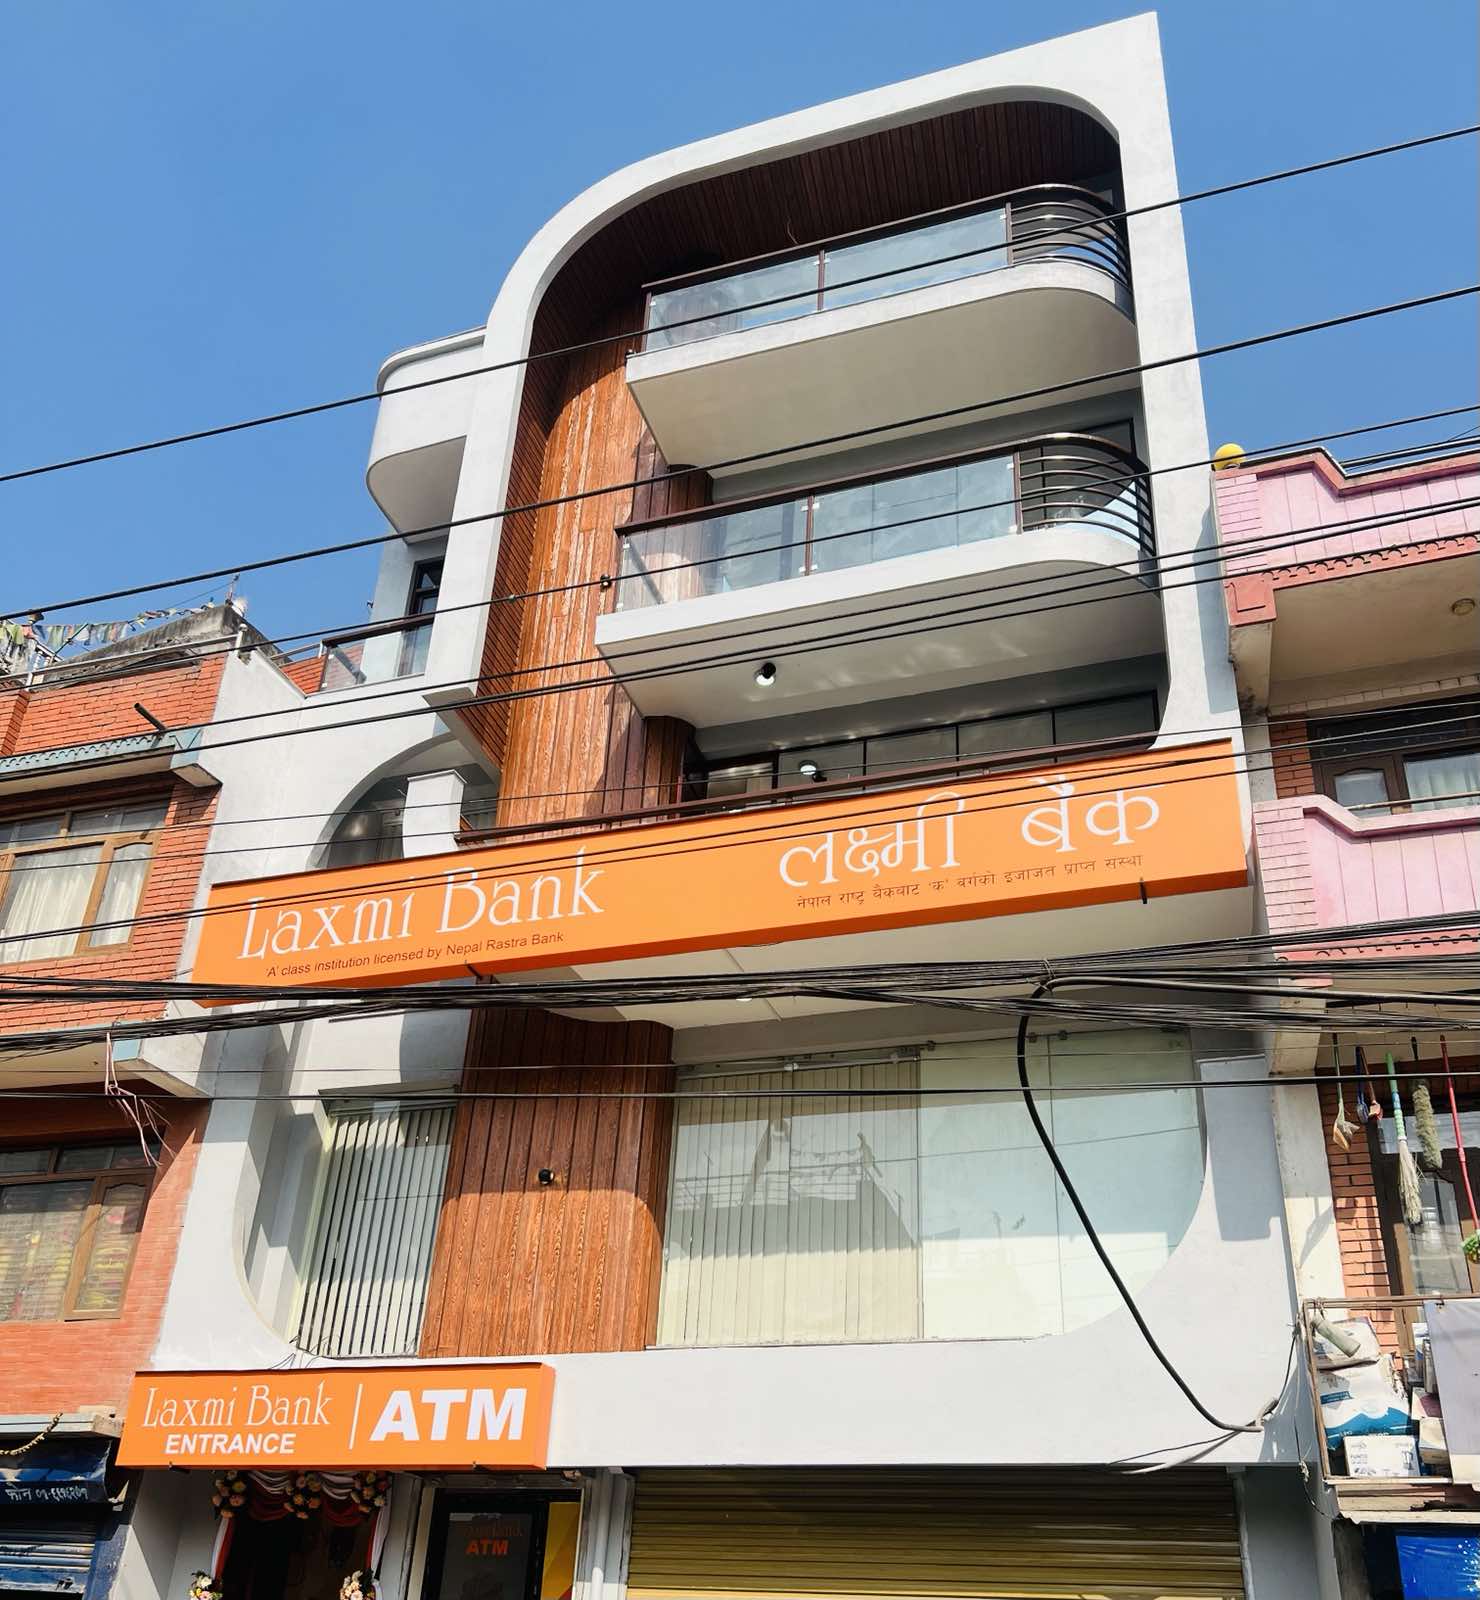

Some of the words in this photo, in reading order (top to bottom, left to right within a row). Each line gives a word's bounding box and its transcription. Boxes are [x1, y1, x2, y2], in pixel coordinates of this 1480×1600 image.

[780, 791, 966, 887] लक्ष्मी
[1021, 774, 1163, 853] बैंक
[236, 877, 415, 960] Laxmi
[436, 846, 606, 934] Bank
[796, 895, 832, 909] नेपाल
[957, 870, 996, 888] वर्गको
[1004, 865, 1057, 884] इजाजत
[1064, 860, 1097, 875] प्राप्त
[280, 962, 311, 975] class
[315, 956, 370, 972] institution
[374, 946, 424, 963] licensed
[427, 947, 442, 960] by
[447, 942, 483, 956] Nepal
[486, 936, 528, 950] Rastra
[532, 932, 564, 945] Bank
[142, 1385, 238, 1427] Laxmi
[246, 1380, 334, 1426] Bank
[369, 1388, 528, 1441] ATM
[165, 1433, 297, 1455] ENTRANCE
[465, 1537, 510, 1556] ATM
